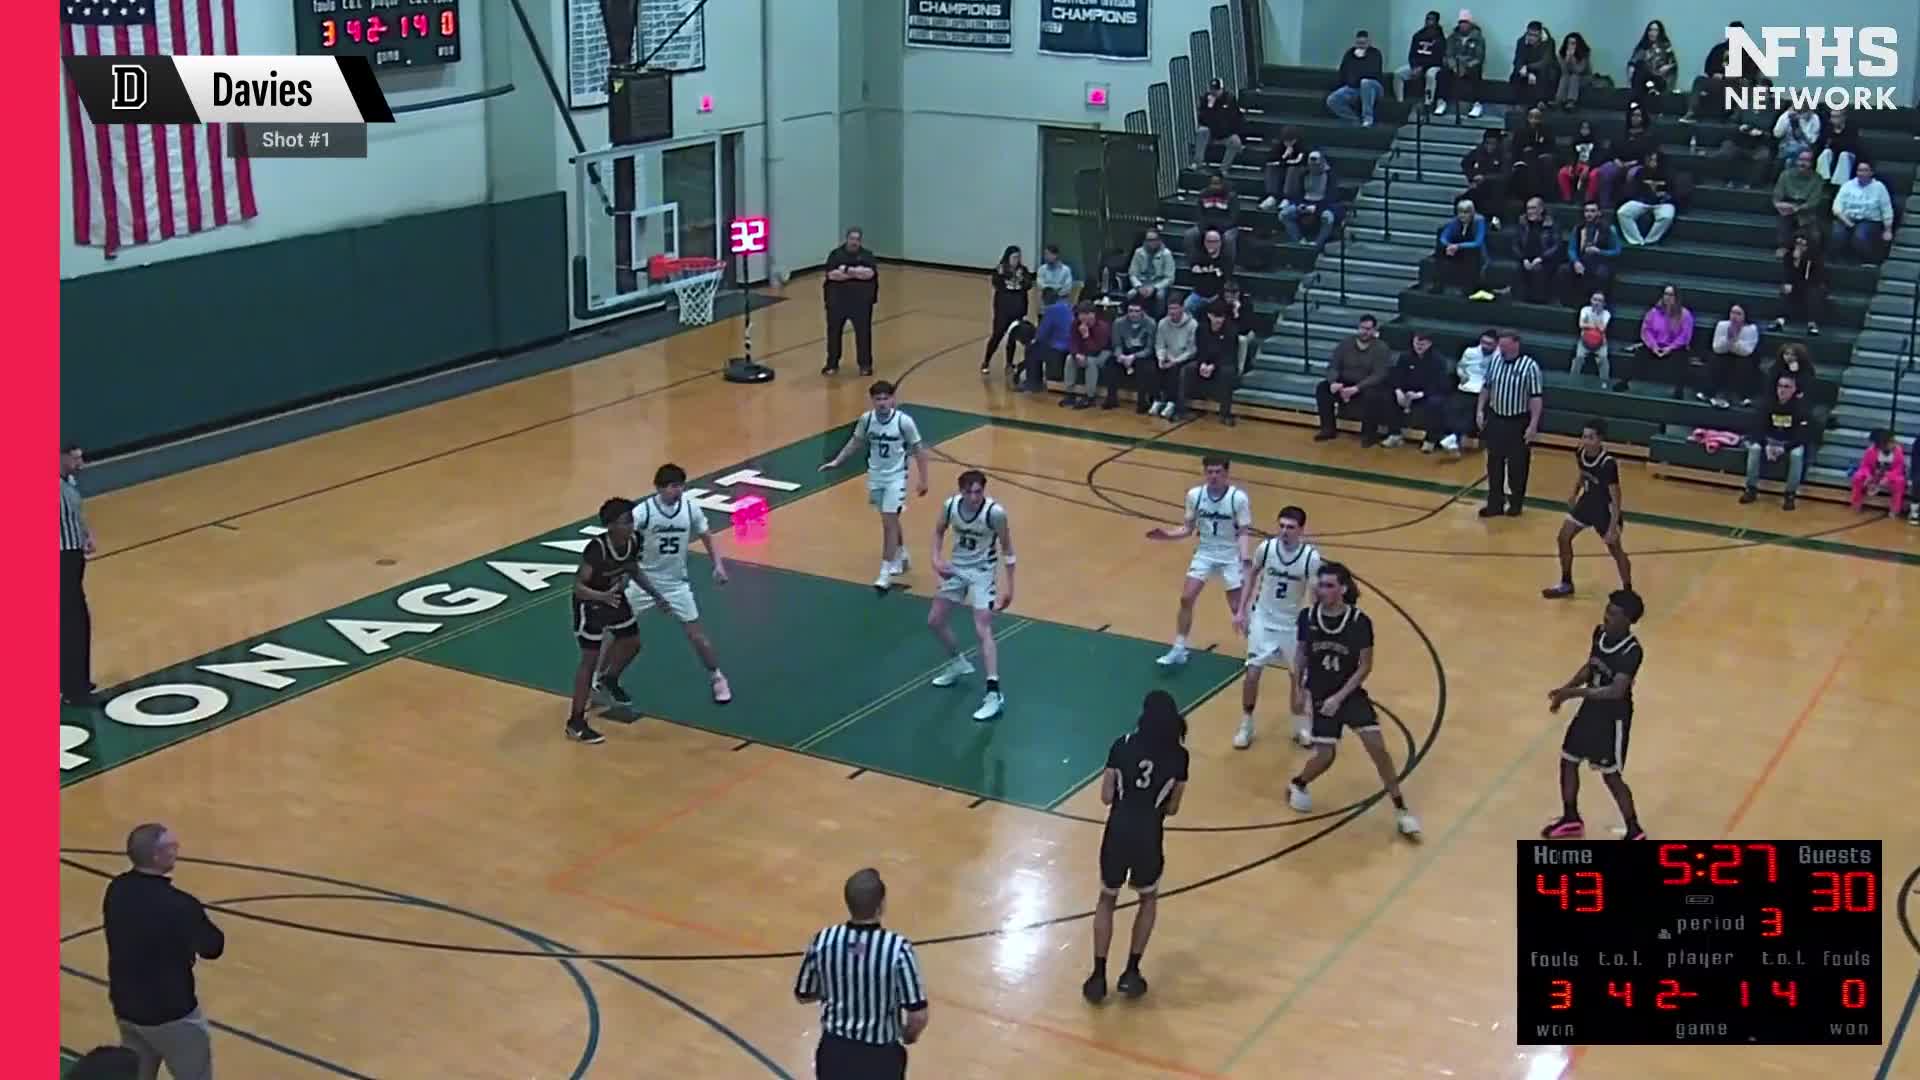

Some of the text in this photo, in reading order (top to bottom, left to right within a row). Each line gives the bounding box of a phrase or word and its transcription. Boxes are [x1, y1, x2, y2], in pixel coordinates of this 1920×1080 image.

[919, 1, 1001, 16] CHAMPIONS
[1052, 7, 1137, 24] CHAMPIONS
[322, 20, 336, 47] 3
[731, 220, 764, 252] 32
[659, 537, 680, 554] 25
[1275, 582, 1288, 599] 2
[1322, 655, 1340, 672] 44
[1136, 760, 1153, 788] 3
